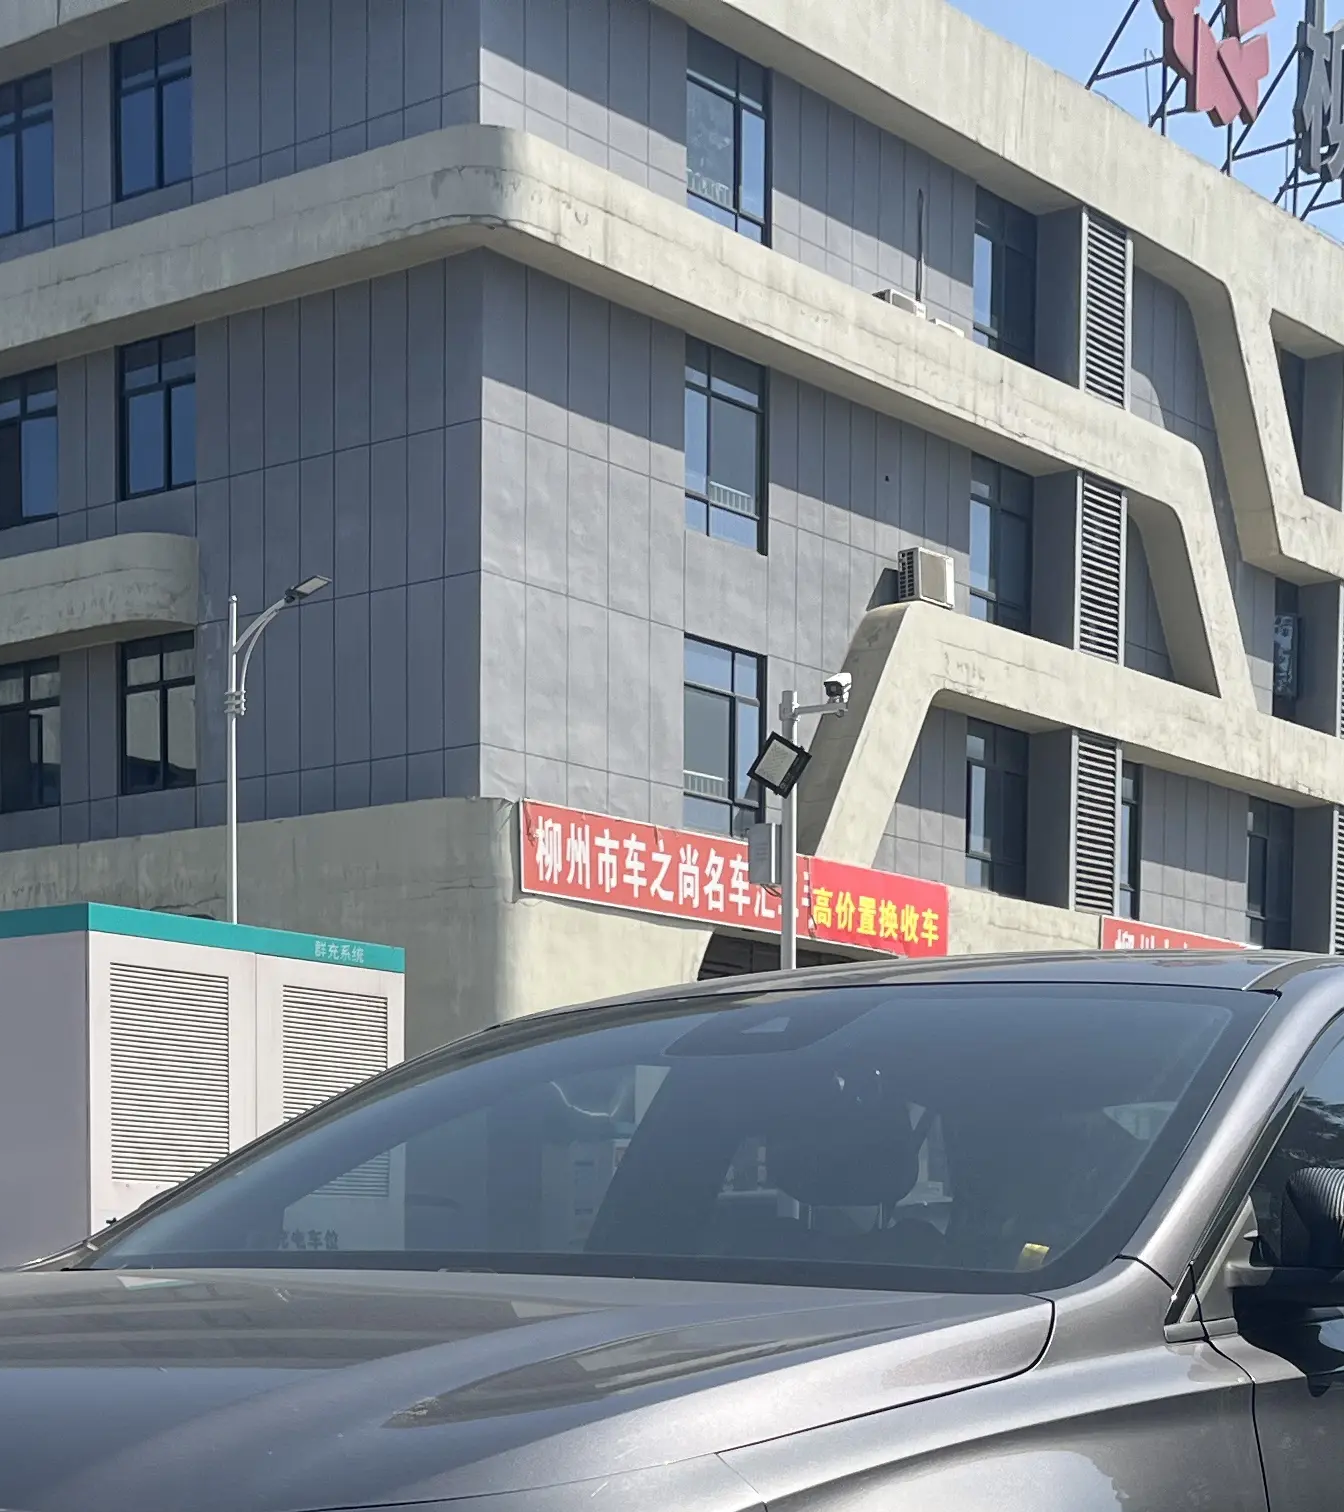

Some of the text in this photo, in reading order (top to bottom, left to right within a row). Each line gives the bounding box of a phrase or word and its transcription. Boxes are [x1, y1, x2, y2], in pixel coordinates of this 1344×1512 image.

[813, 887, 940, 947] 高价置换收车
[314, 940, 364, 963] 群充系统
